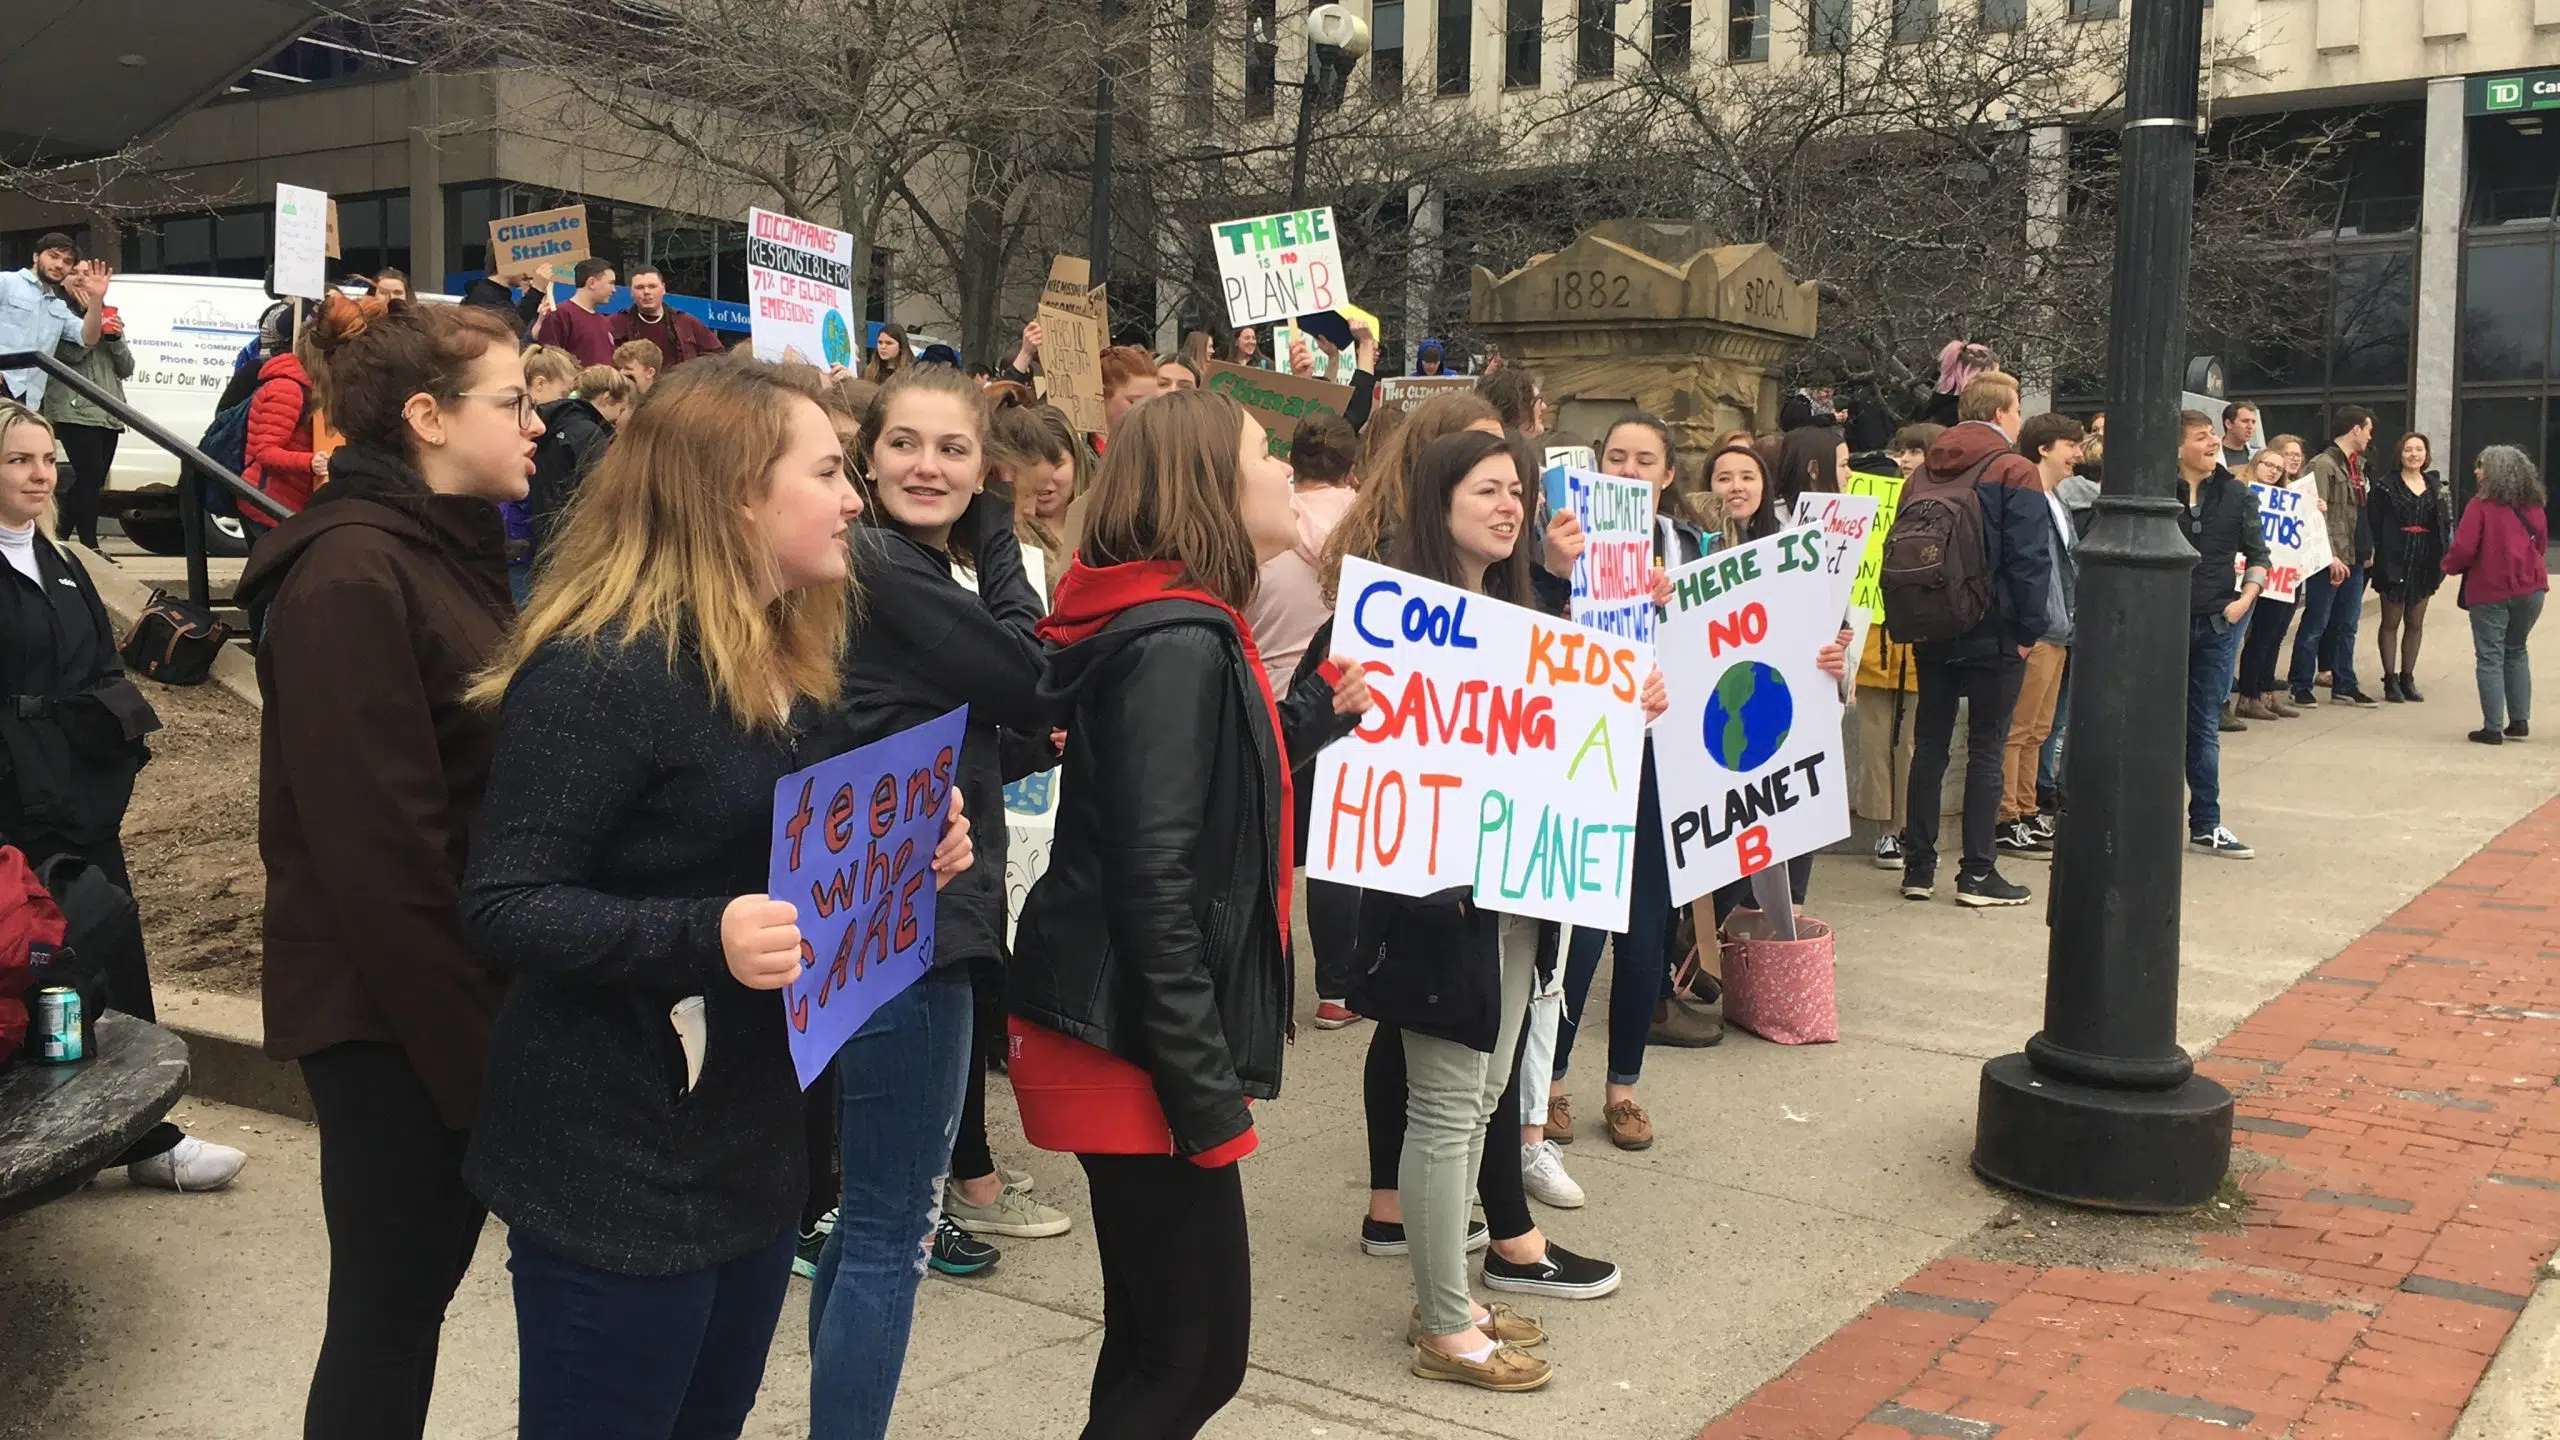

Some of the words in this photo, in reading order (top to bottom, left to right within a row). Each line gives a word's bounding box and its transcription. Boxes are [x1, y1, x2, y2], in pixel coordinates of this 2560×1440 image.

[2491, 84, 2519, 103] TD
[497, 216, 580, 243] Climate
[511, 239, 573, 262] Strike
[773, 215, 838, 254] COMPANIES
[1217, 209, 1330, 256] THERE
[750, 238, 833, 283] RESPONSIBLE
[834, 263, 850, 288] FOR
[1256, 253, 1271, 269] is
[1280, 252, 1298, 265] no
[753, 270, 775, 290] 71%
[780, 276, 796, 296] OF
[800, 279, 839, 309] GLOBAL
[1309, 261, 1333, 310] B
[1552, 270, 1630, 311] 1882
[717, 310, 729, 322] of
[760, 296, 815, 325] EMISSIONS
[132, 339, 183, 349] RESIDENTIAL
[138, 370, 150, 383] Us
[154, 371, 174, 384] Cut
[177, 373, 196, 385] Our
[200, 374, 221, 388] Way
[1384, 382, 1404, 401] THE
[1569, 476, 1591, 535] THE
[1593, 480, 1648, 535] CLIMATE
[1821, 499, 1868, 540] Choices
[2269, 487, 2302, 512] BET
[1590, 540, 1654, 602] CHANGING
[1776, 529, 1821, 574] IS
[1353, 580, 1478, 649] COOL
[1526, 623, 1636, 704] KIDS
[1708, 601, 1768, 659] NO
[1353, 660, 1556, 756] SAVING
[1567, 713, 1618, 792] A
[784, 744, 954, 873] teens
[1670, 751, 1825, 869] PLANET
[1327, 762, 1463, 875] HOT
[1472, 789, 1637, 902] PLANET
[1736, 825, 1773, 877] B
[810, 837, 914, 920] who
[788, 868, 926, 1034] CARE
